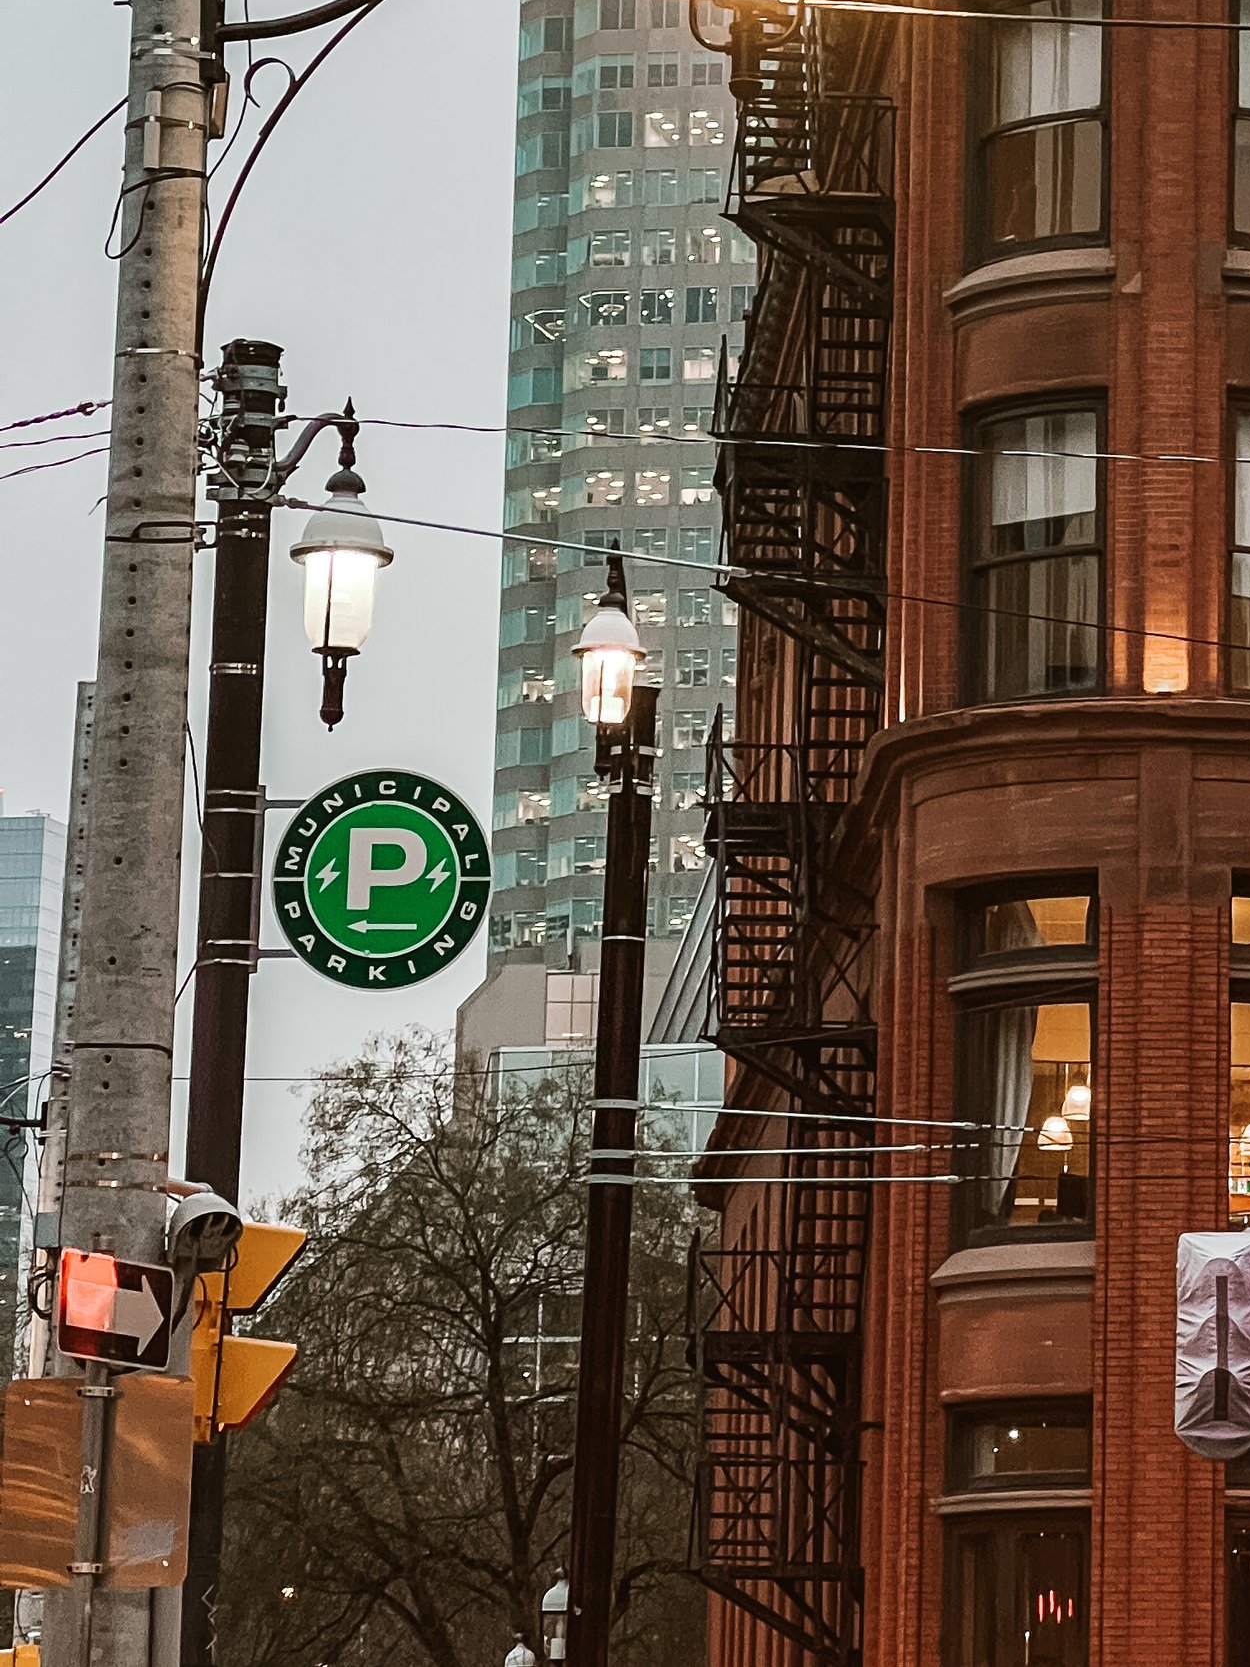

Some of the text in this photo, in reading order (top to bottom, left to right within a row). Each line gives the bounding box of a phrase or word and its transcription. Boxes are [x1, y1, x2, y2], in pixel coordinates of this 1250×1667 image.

[284, 780, 480, 871] MUNICIPAL
[346, 827, 428, 911] P
[284, 900, 478, 981] PARKING
